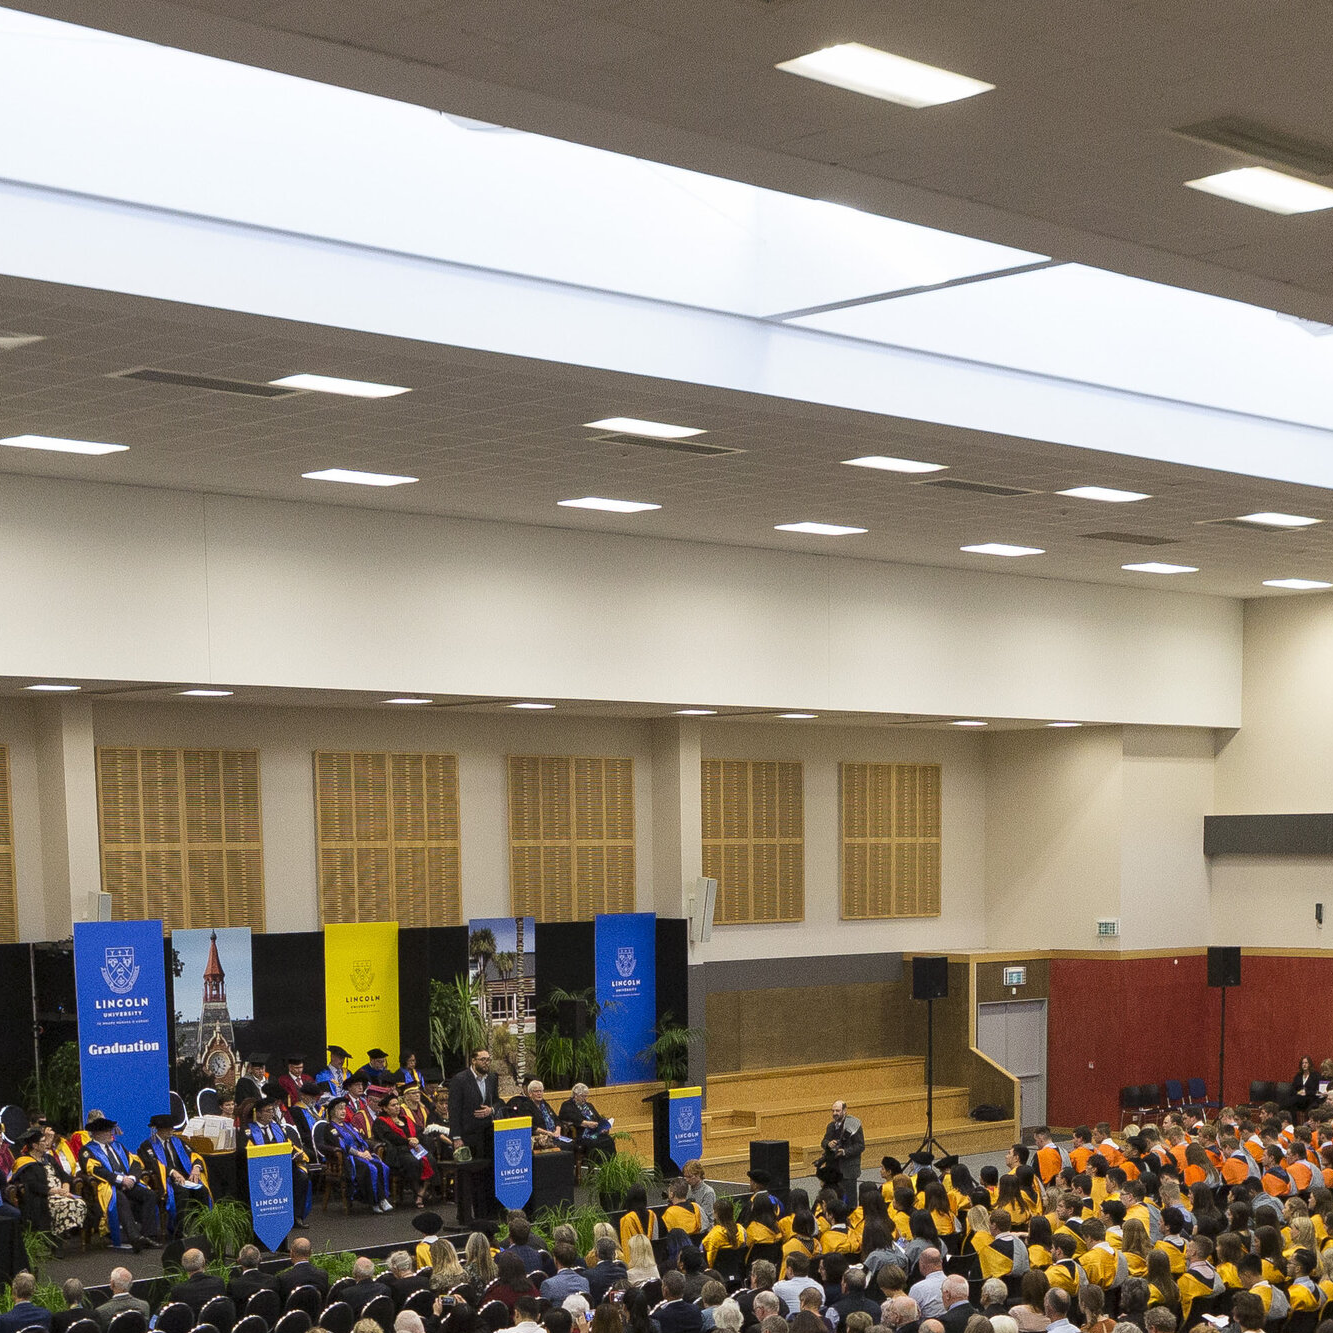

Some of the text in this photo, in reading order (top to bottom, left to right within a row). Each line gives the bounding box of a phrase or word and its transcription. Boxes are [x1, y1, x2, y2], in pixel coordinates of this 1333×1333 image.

[611, 979, 641, 987] LINCOLN
[95, 997, 149, 1009] LINCOLN
[345, 995, 380, 1003] LINCOLN
[103, 1010, 143, 1018] UNIVERSITY
[88, 1040, 160, 1056] Graduation
[675, 1131, 699, 1139] LINCOLN
[500, 1167, 529, 1176] LINCOLN
[255, 1197, 288, 1207] LINCOLN
